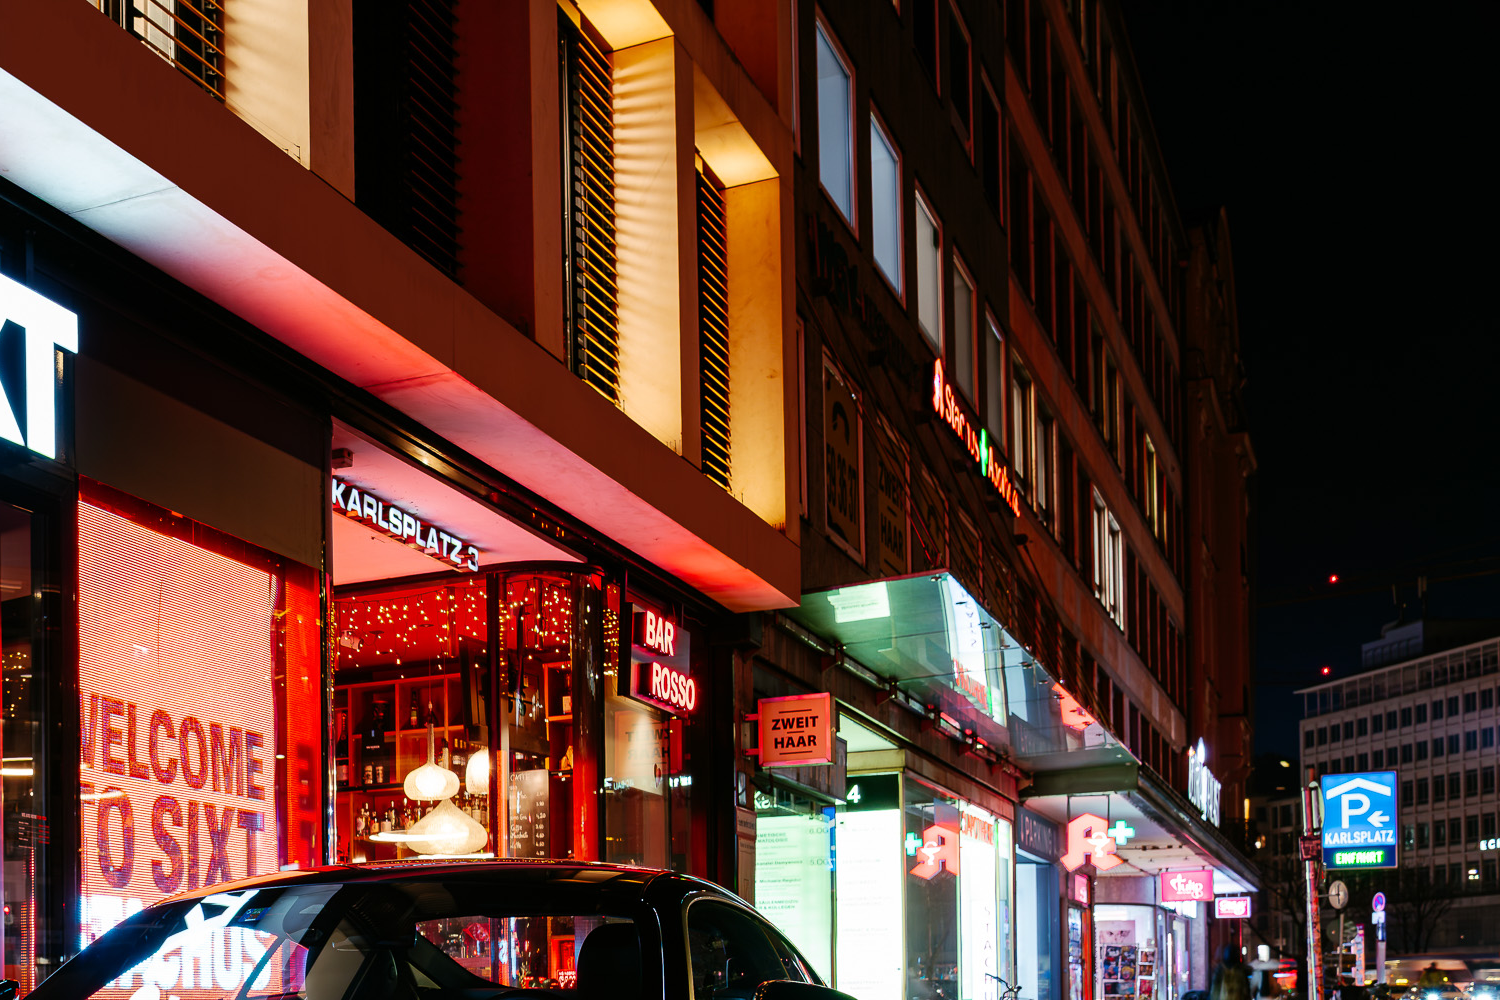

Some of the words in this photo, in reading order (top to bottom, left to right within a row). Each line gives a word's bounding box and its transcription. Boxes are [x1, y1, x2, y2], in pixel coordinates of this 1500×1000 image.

[332, 479, 463, 564] KARLSPLATZ
[467, 546, 479, 572] 3
[645, 611, 674, 656] BAR
[652, 662, 696, 710] ROSSO
[771, 716, 819, 731] ZWEIT
[774, 735, 817, 749] HAAR
[847, 784, 861, 803] 4
[1341, 793, 1371, 829] P
[151, 795, 265, 894] SIXT
[1325, 830, 1394, 845] KARLSPLATZ
[1335, 851, 1384, 864] EINFAHRT
